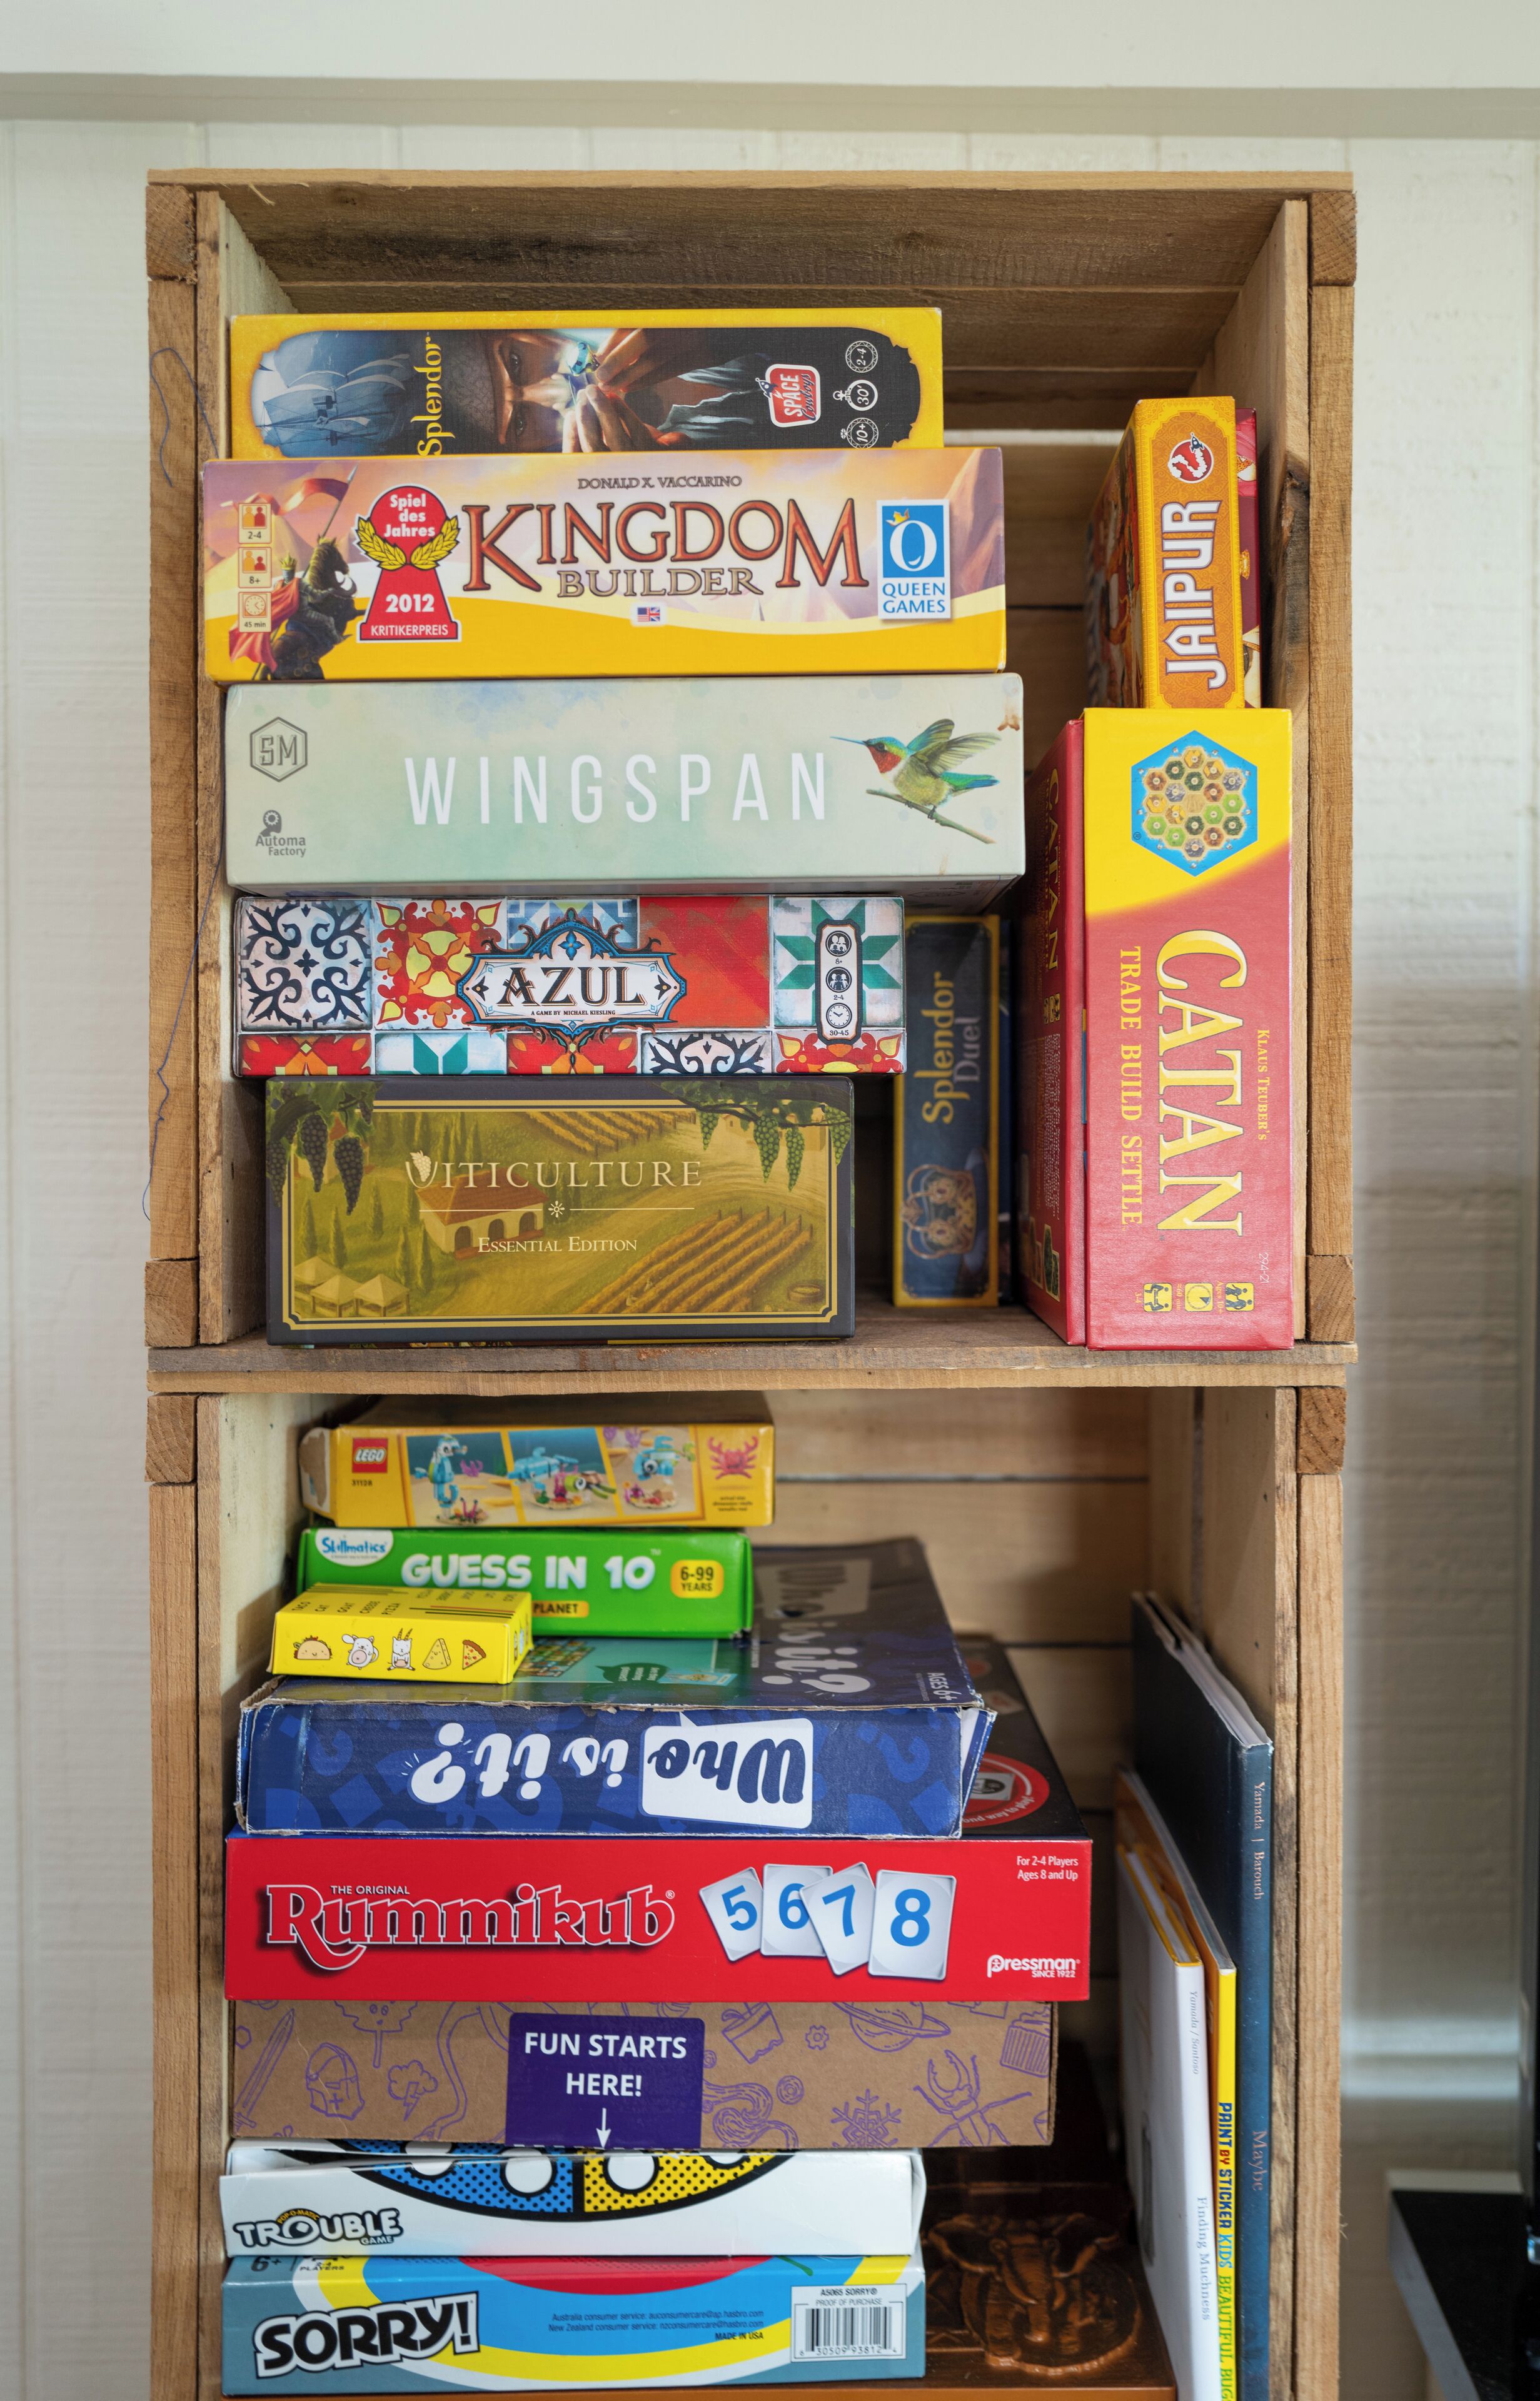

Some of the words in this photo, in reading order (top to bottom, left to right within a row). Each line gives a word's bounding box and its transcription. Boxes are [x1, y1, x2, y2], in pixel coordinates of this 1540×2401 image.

[858, 348, 867, 365] 2-4
[411, 335, 455, 456] Splendor
[784, 374, 803, 418] SPACE
[802, 374, 817, 421] Cowboys
[857, 385, 870, 405] 30'
[857, 424, 867, 443] 10+
[578, 478, 640, 490] DONALD
[658, 476, 742, 488] VACCARINO
[390, 494, 426, 509] Spiel
[399, 510, 426, 523] des
[248, 531, 261, 540] 2-4
[385, 524, 436, 539] Jahres
[463, 498, 870, 592] KINGDOM
[249, 576, 261, 585] 8+
[558, 568, 764, 598] BUILDER
[882, 583, 945, 598] QUEEN
[386, 595, 435, 613] 2012
[882, 600, 945, 614] GAMES
[1161, 500, 1228, 692] JAIPUR
[370, 626, 448, 637] KRITIKERPREIS
[259, 734, 299, 767] SM
[405, 753, 825, 825] WINGSPAN
[255, 835, 306, 847] Automa
[268, 847, 306, 857] Factory
[496, 966, 648, 1008] AZUL
[1120, 946, 1142, 1030] TRADE
[914, 971, 970, 1124] Splendor
[954, 1017, 981, 1082] Duel
[1257, 1029, 1270, 1072] KLAUS
[1120, 1044, 1142, 1121] BUILD
[1155, 929, 1248, 1237] CATAN
[1257, 1076, 1270, 1140] TEUBER'S
[405, 1160, 702, 1188] VITICULTURE
[1120, 1135, 1143, 1225] SETTLE
[478, 1237, 562, 1252] ESSENTIAL
[568, 1236, 638, 1252] EDITION
[355, 1448, 386, 1464] LEGO
[321, 1536, 386, 1554] Skillmatics
[401, 1554, 531, 1589] GUESS
[545, 1556, 587, 1588] IN
[680, 1566, 714, 1581] 6-99
[682, 1583, 712, 1592] YEARS
[533, 1603, 578, 1614] PLANET
[927, 1673, 950, 1689] AGES
[934, 1689, 962, 1701] 6+
[410, 1722, 550, 1805] it?
[563, 1737, 628, 1788] is
[647, 1737, 805, 1803] Who
[986, 1811, 1007, 1820] way
[1007, 1805, 1019, 1814] to
[1016, 1795, 1035, 1810] play!
[1254, 1782, 1266, 1830] Yamada
[1017, 1855, 1030, 1866] For
[1032, 1855, 1046, 1866] 2-4
[1048, 1856, 1079, 1868] Players
[1017, 1870, 1039, 1881] Ages
[1040, 1870, 1047, 1879] 8
[1048, 1870, 1064, 1879] and
[1065, 1870, 1079, 1881] Up
[1254, 1851, 1266, 1900] Barouch
[331, 1885, 351, 1893] THE
[356, 1885, 410, 1895] ORIGINAL
[722, 1885, 757, 1931] 5
[778, 1883, 809, 1930] 6
[822, 1885, 856, 1937] 7
[890, 1889, 931, 1946] 8
[1189, 1991, 1199, 2028] Yamada
[525, 2033, 579, 2055] FUN
[588, 2035, 687, 2058] STARTS
[566, 2073, 642, 2096] HERE!
[1218, 2102, 1232, 2148] PAINT
[1219, 2150, 1230, 2165] BY
[1247, 2130, 1267, 2191] Maybe
[1219, 2169, 1232, 2229] STICKER
[234, 2208, 404, 2247] TROUBLE
[277, 2208, 320, 2224] POP-O-MATIC
[1197, 2197, 1208, 2249] Finding
[361, 2236, 394, 2245] GAME
[1218, 2233, 1233, 2268] KIDS
[251, 2255, 281, 2272] 6+
[1200, 2253, 1210, 2321] Muchness
[549, 2324, 564, 2332] New
[566, 2323, 593, 2332] Zealand
[595, 2323, 629, 2332] consumer
[632, 2323, 657, 2331] service:
[553, 2313, 582, 2322] Australia
[585, 2313, 618, 2321] consumer
[1218, 2275, 1234, 2362] BEAUTIFUL
[260, 2304, 470, 2372] SORRY!
[715, 2332, 737, 2340] MADE
[749, 2331, 764, 2340] USA
[1220, 2368, 1234, 2401] BUG
